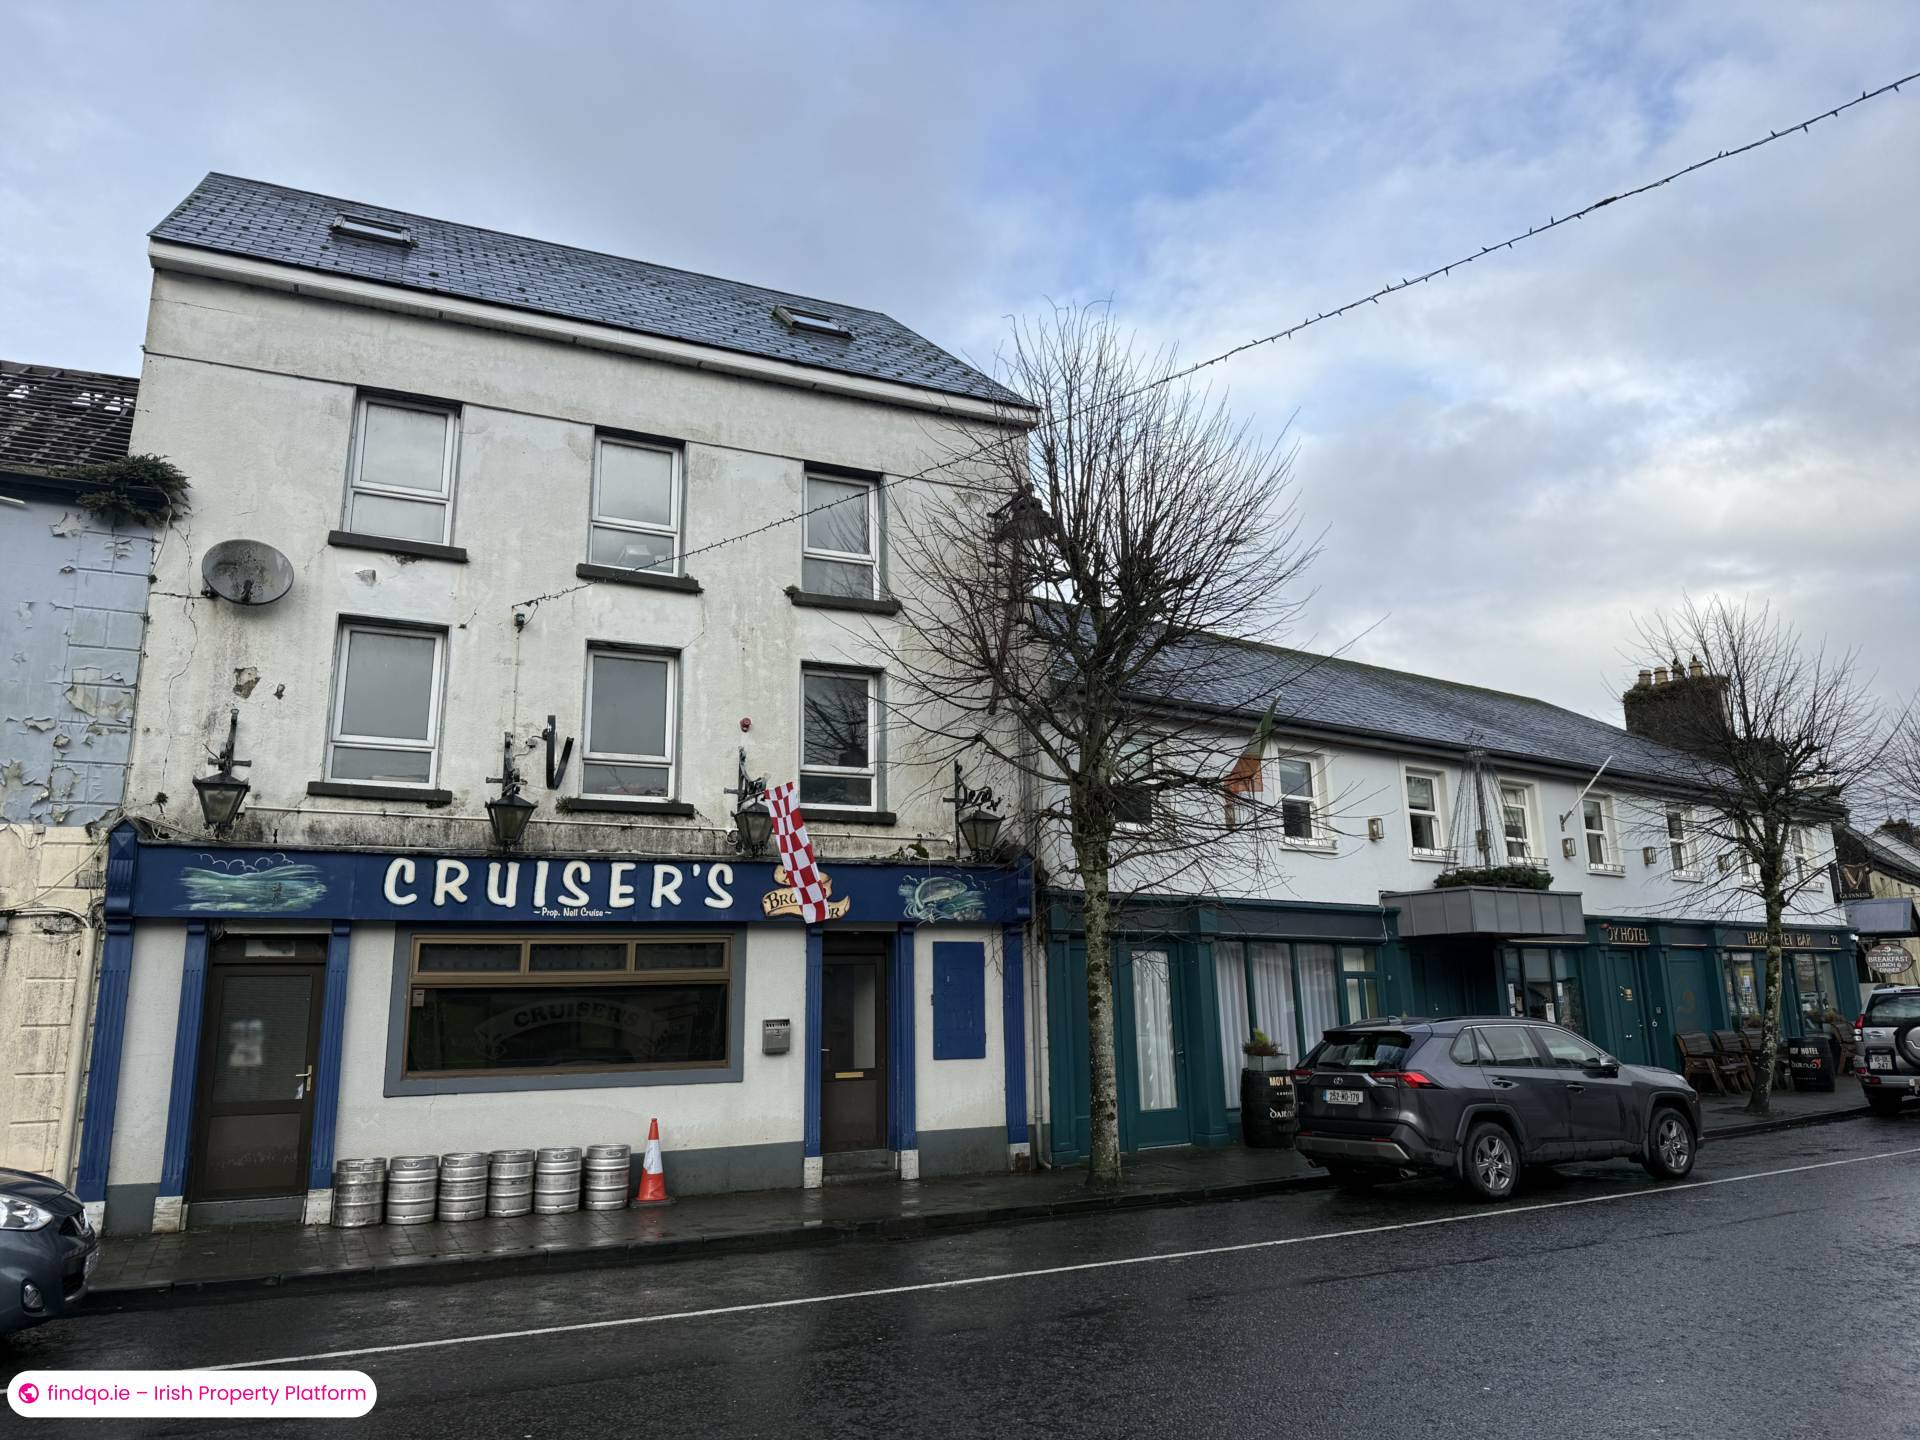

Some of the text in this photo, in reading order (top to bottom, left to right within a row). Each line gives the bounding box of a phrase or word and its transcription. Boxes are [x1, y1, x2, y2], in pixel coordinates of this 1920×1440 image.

[383, 857, 735, 910] CRUISER'S
[580, 907, 604, 917] Cruise
[1620, 927, 1648, 942] HOTEL
[1796, 933, 1812, 946] BAR
[1830, 934, 1839, 945] 22
